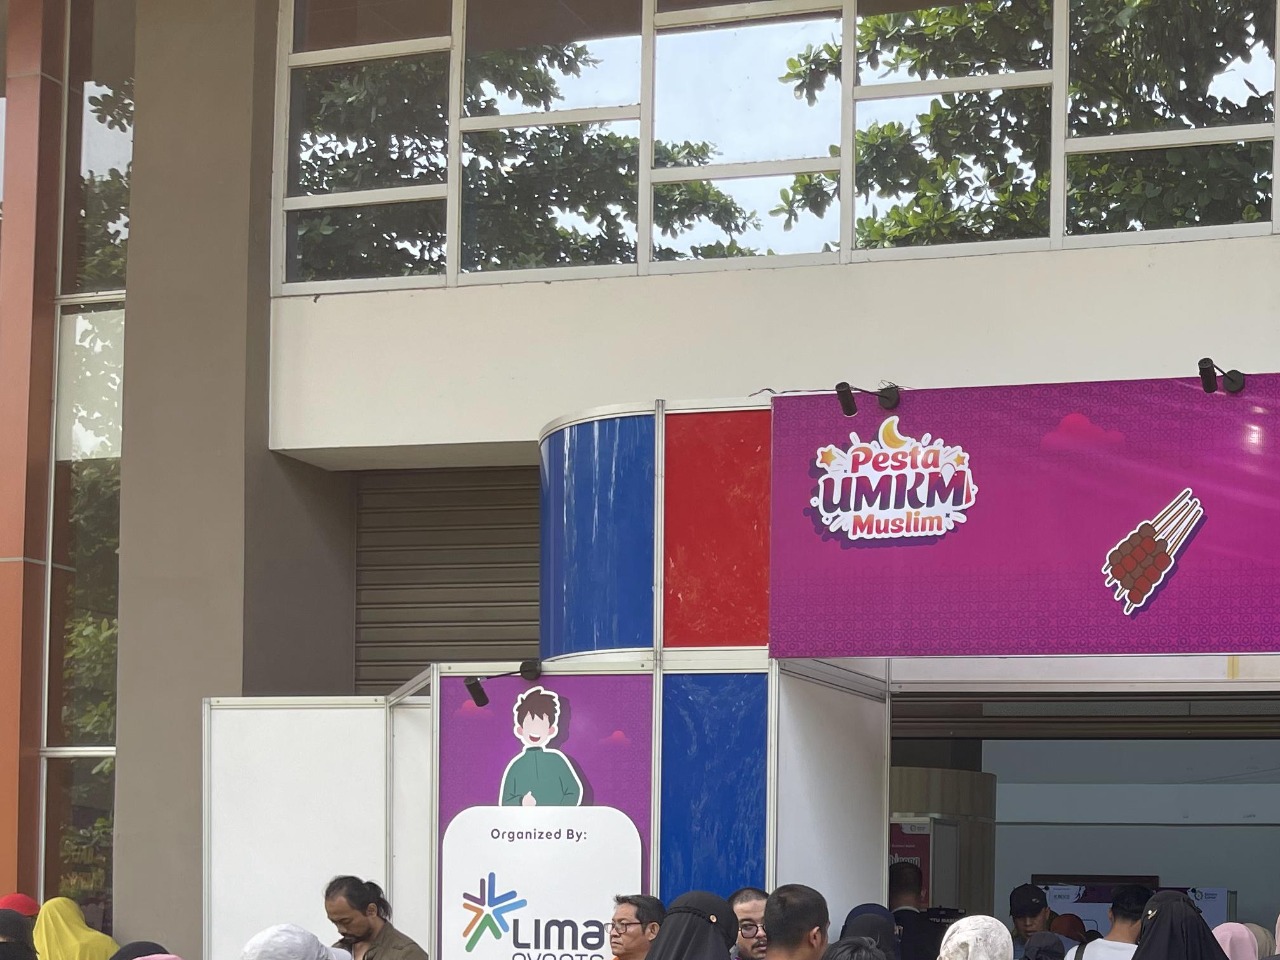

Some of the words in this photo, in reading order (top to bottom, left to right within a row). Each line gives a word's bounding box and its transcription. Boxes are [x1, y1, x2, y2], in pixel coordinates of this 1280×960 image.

[851, 446, 940, 473] Pesta
[823, 470, 966, 513] UMKM
[852, 511, 943, 536] Muslim
[490, 828, 562, 842] Organized
[566, 828, 587, 842] By:
